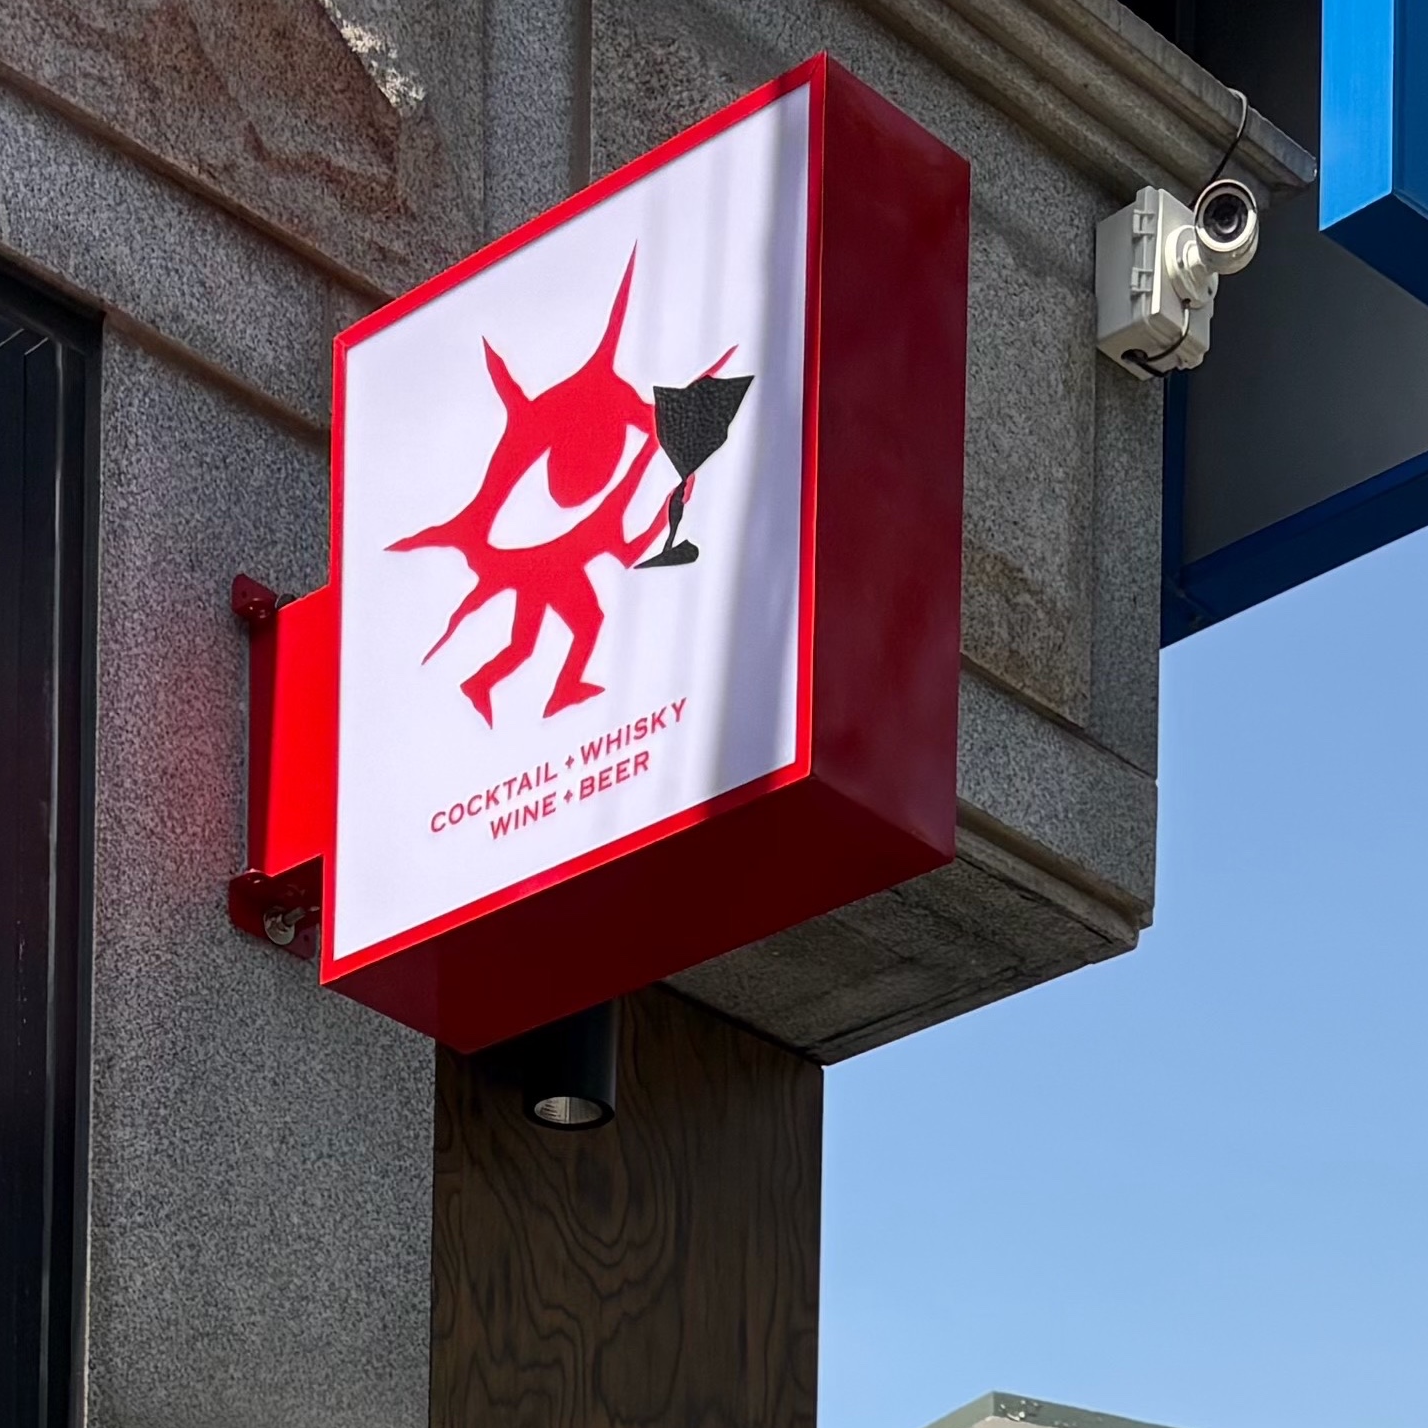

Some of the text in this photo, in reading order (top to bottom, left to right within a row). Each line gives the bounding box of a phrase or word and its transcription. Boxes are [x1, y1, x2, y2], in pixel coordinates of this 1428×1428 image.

[431, 741, 559, 832] COCKTAIL
[580, 698, 688, 766] WHISKY
[489, 790, 558, 841] WINE
[579, 750, 650, 801] BEER
